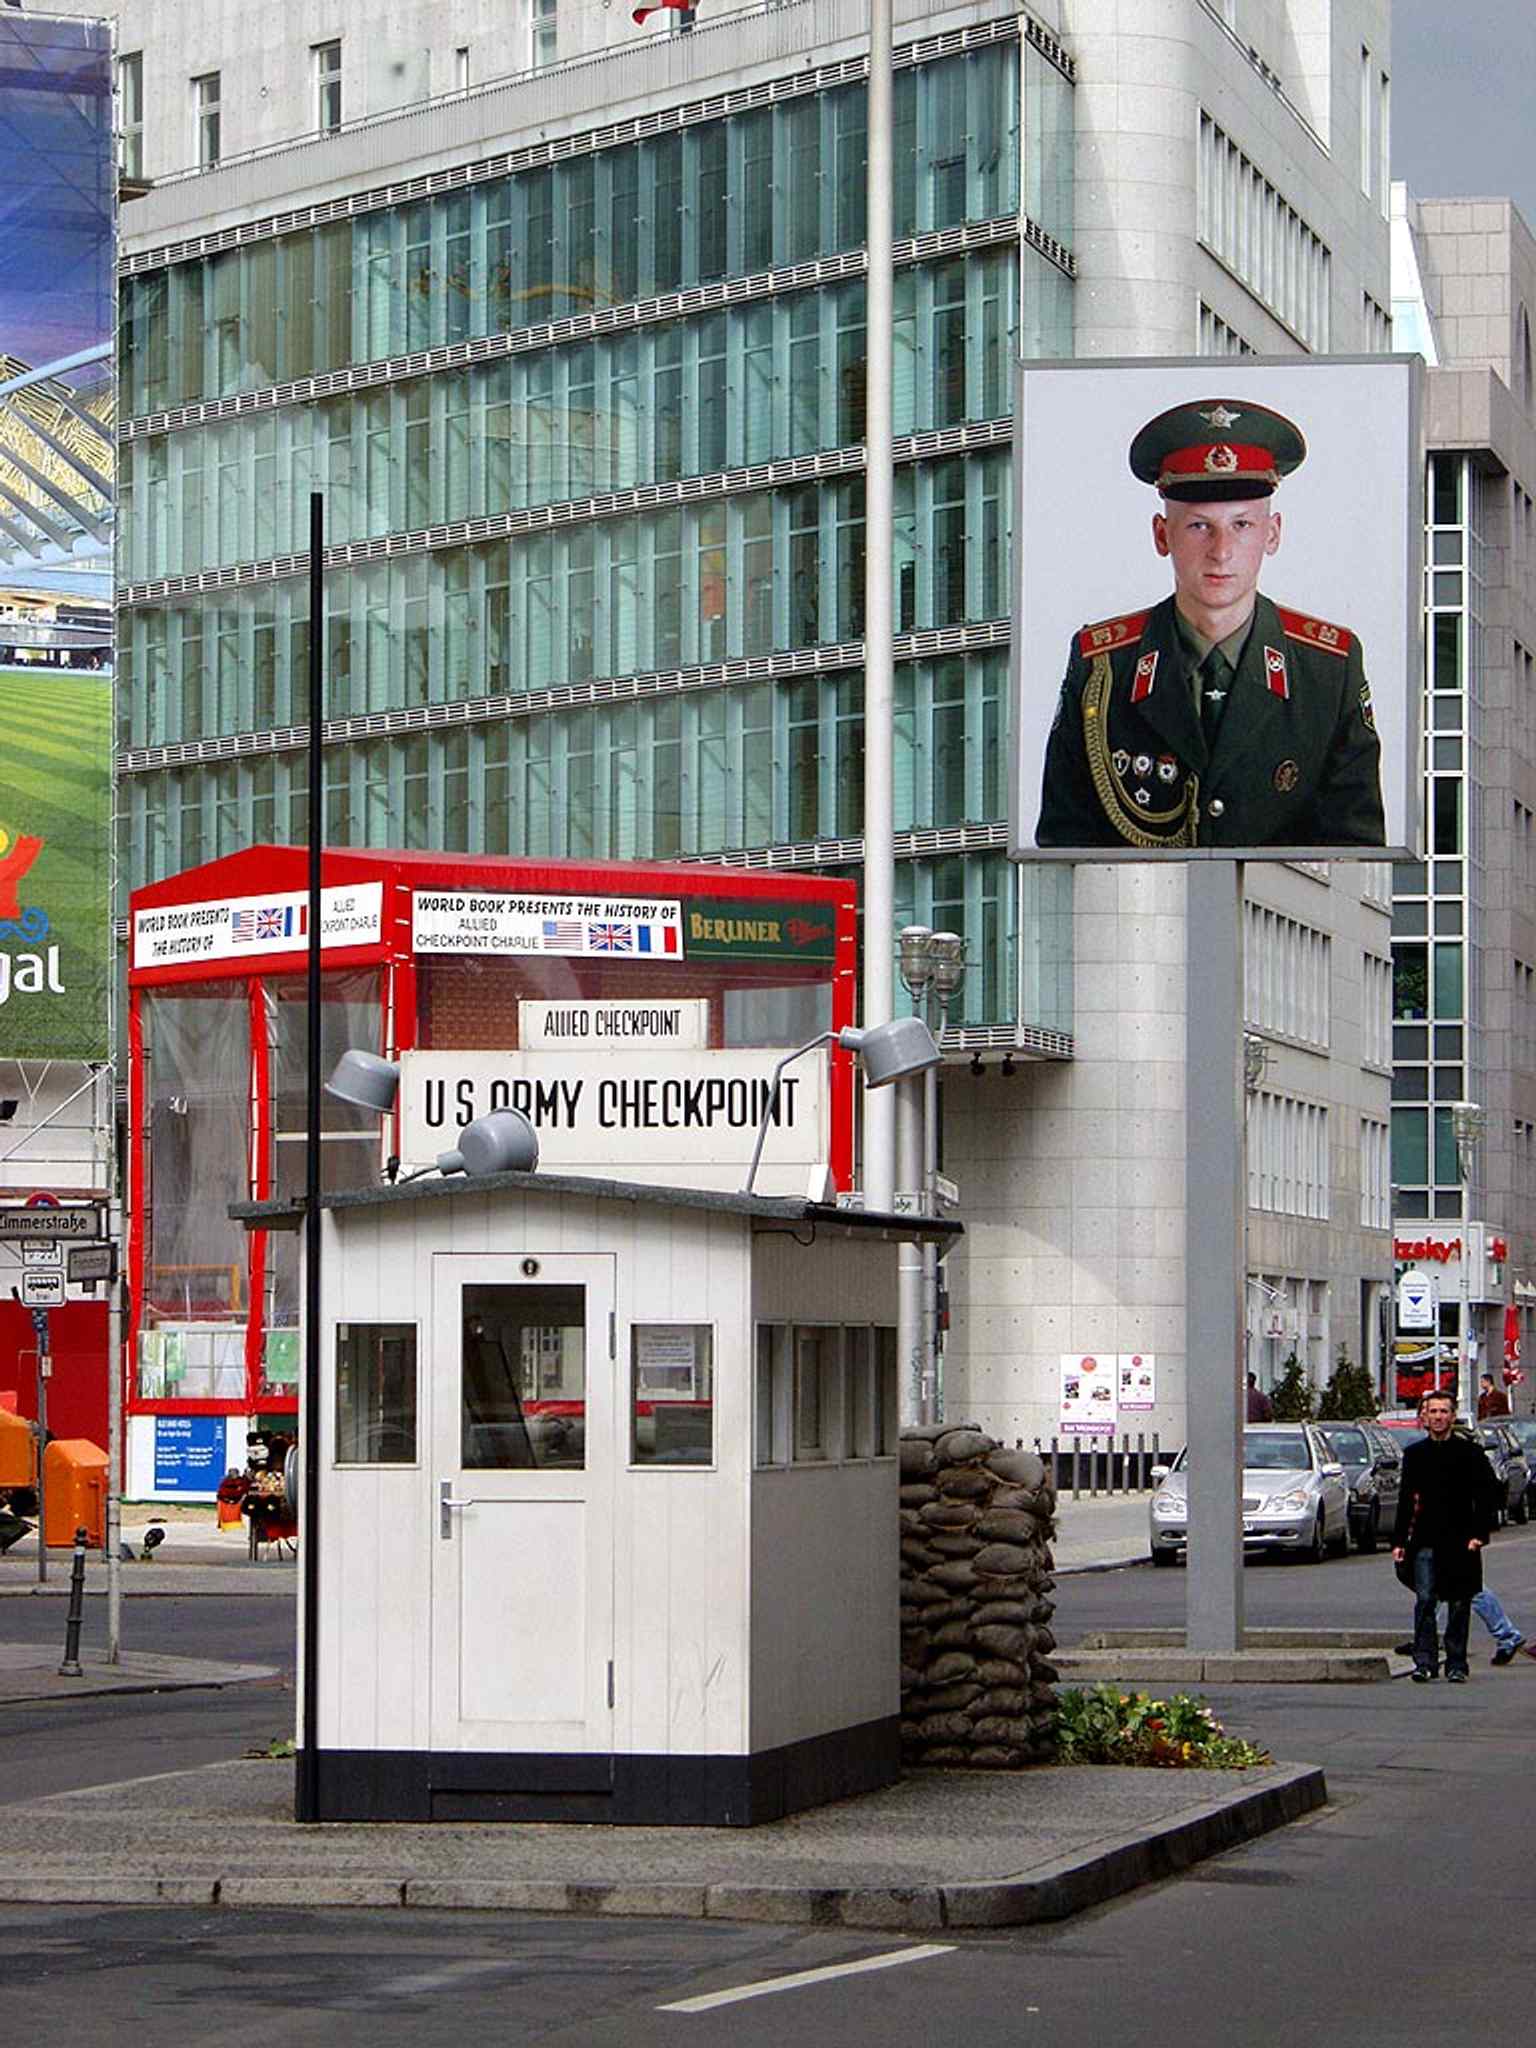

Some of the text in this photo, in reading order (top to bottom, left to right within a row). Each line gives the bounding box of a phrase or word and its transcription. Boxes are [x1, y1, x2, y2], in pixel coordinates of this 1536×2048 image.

[418, 897, 677, 919] WORLD BOOK PRESENTS THE HISTORY OF
[458, 918, 497, 931] ALLIED
[690, 912, 781, 943] BERLINER
[416, 934, 539, 949] CHECKPOINT CHARLIE
[544, 1010, 682, 1037] ALLIED CHECKPOINT
[598, 1078, 800, 1128] CHECKPOINT
